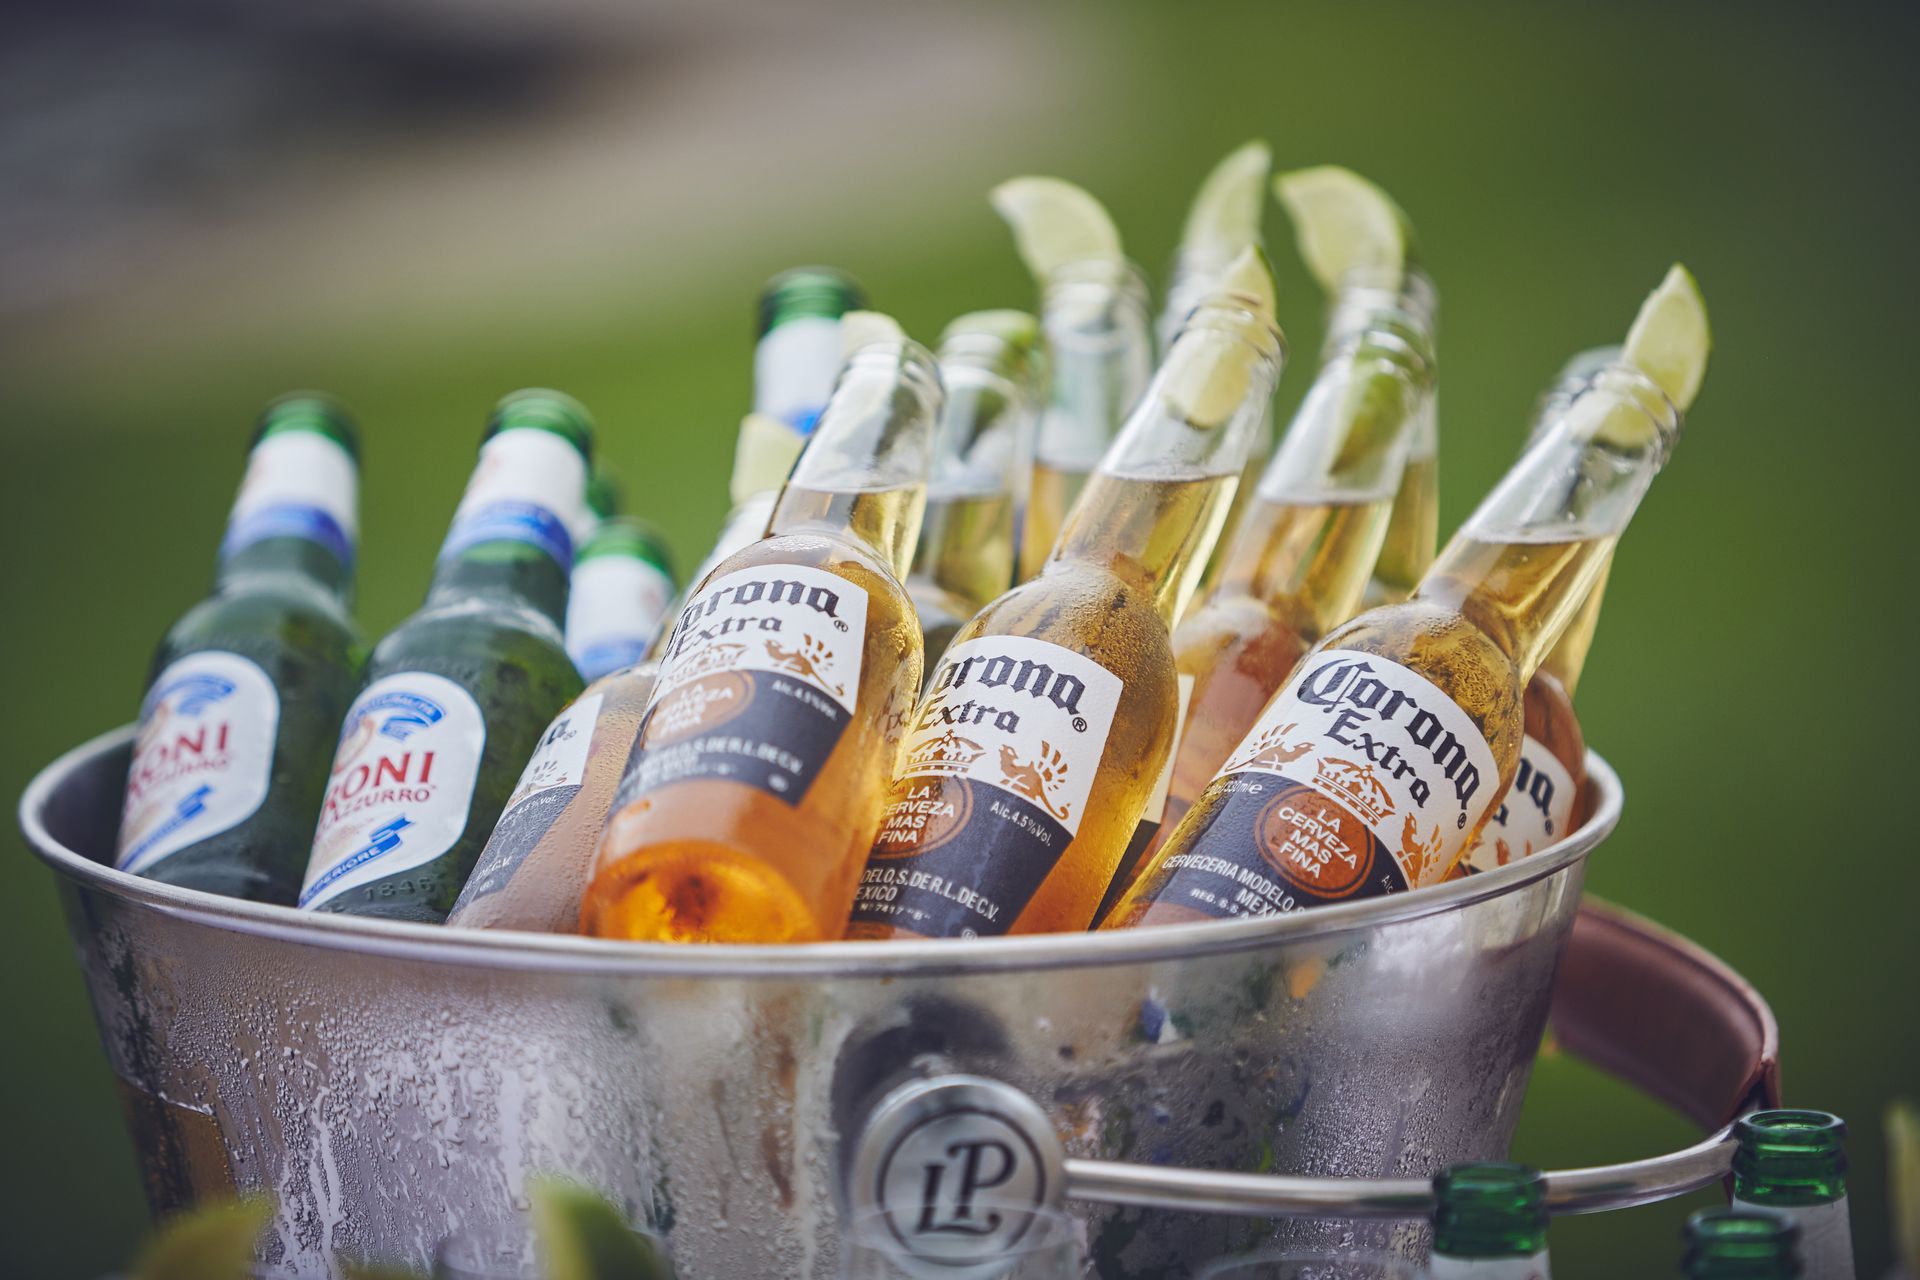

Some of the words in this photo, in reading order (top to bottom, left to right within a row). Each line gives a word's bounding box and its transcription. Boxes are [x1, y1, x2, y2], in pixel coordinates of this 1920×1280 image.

[932, 654, 1086, 716] orona
[914, 693, 1021, 734] Extra
[1297, 658, 1480, 810] Corona
[1323, 708, 1431, 808] Extra
[907, 785, 930, 799] LA
[878, 829, 918, 844] FINA
[886, 815, 927, 829] MAS
[1278, 806, 1358, 870] CERVEZA
[1317, 808, 1341, 833] LA
[1280, 841, 1321, 879] FINA
[1290, 829, 1333, 865] MAS
[1161, 853, 1240, 880] CERVECERIA
[1237, 867, 1295, 912] MODELO
[914, 1138, 1017, 1237] LP
